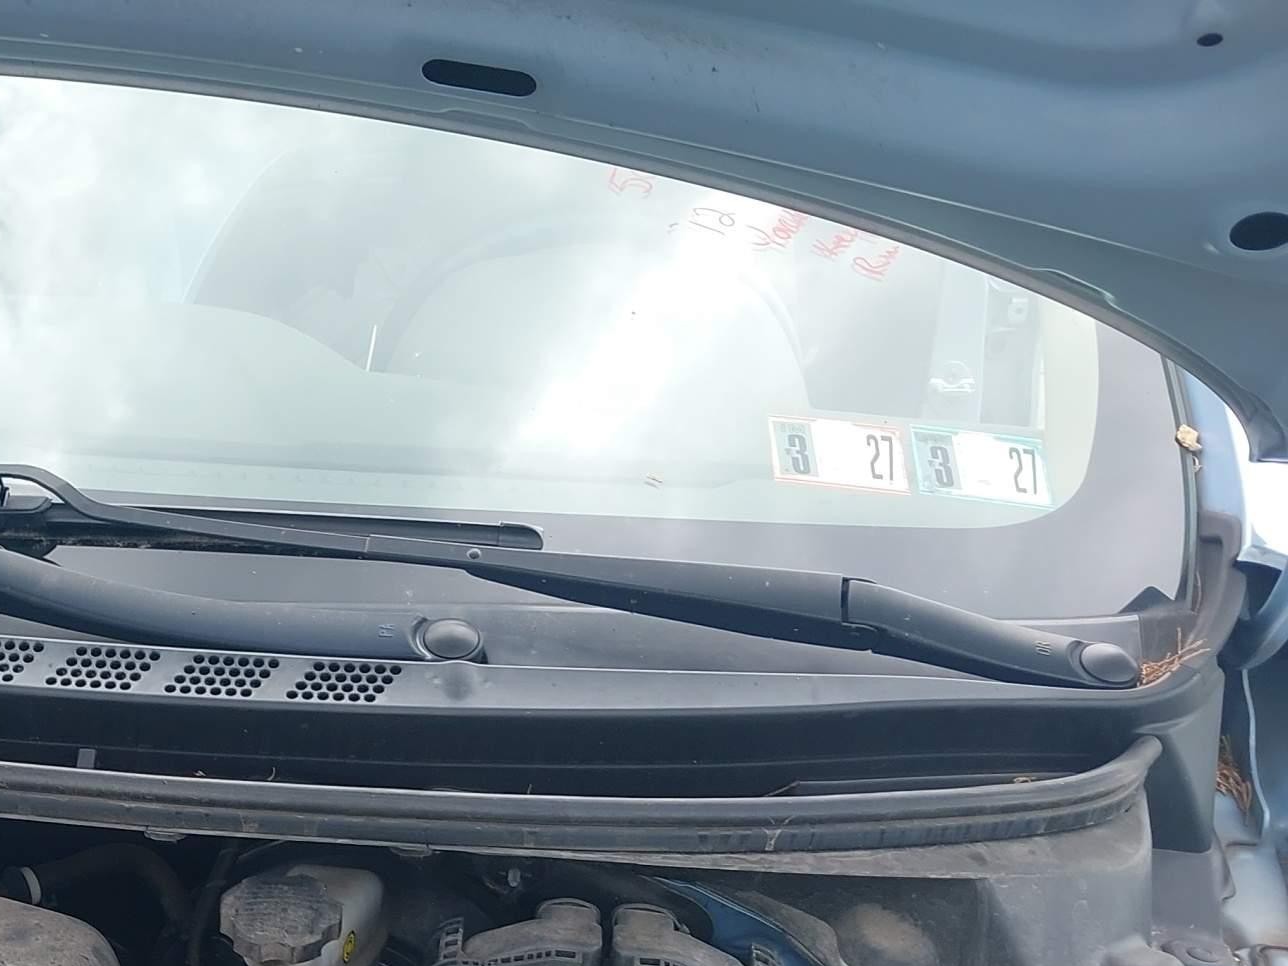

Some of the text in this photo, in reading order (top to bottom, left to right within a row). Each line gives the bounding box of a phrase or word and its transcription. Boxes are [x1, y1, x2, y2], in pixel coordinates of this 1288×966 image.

[786, 433, 894, 481] 3 27
[929, 446, 1037, 495] 3 27
